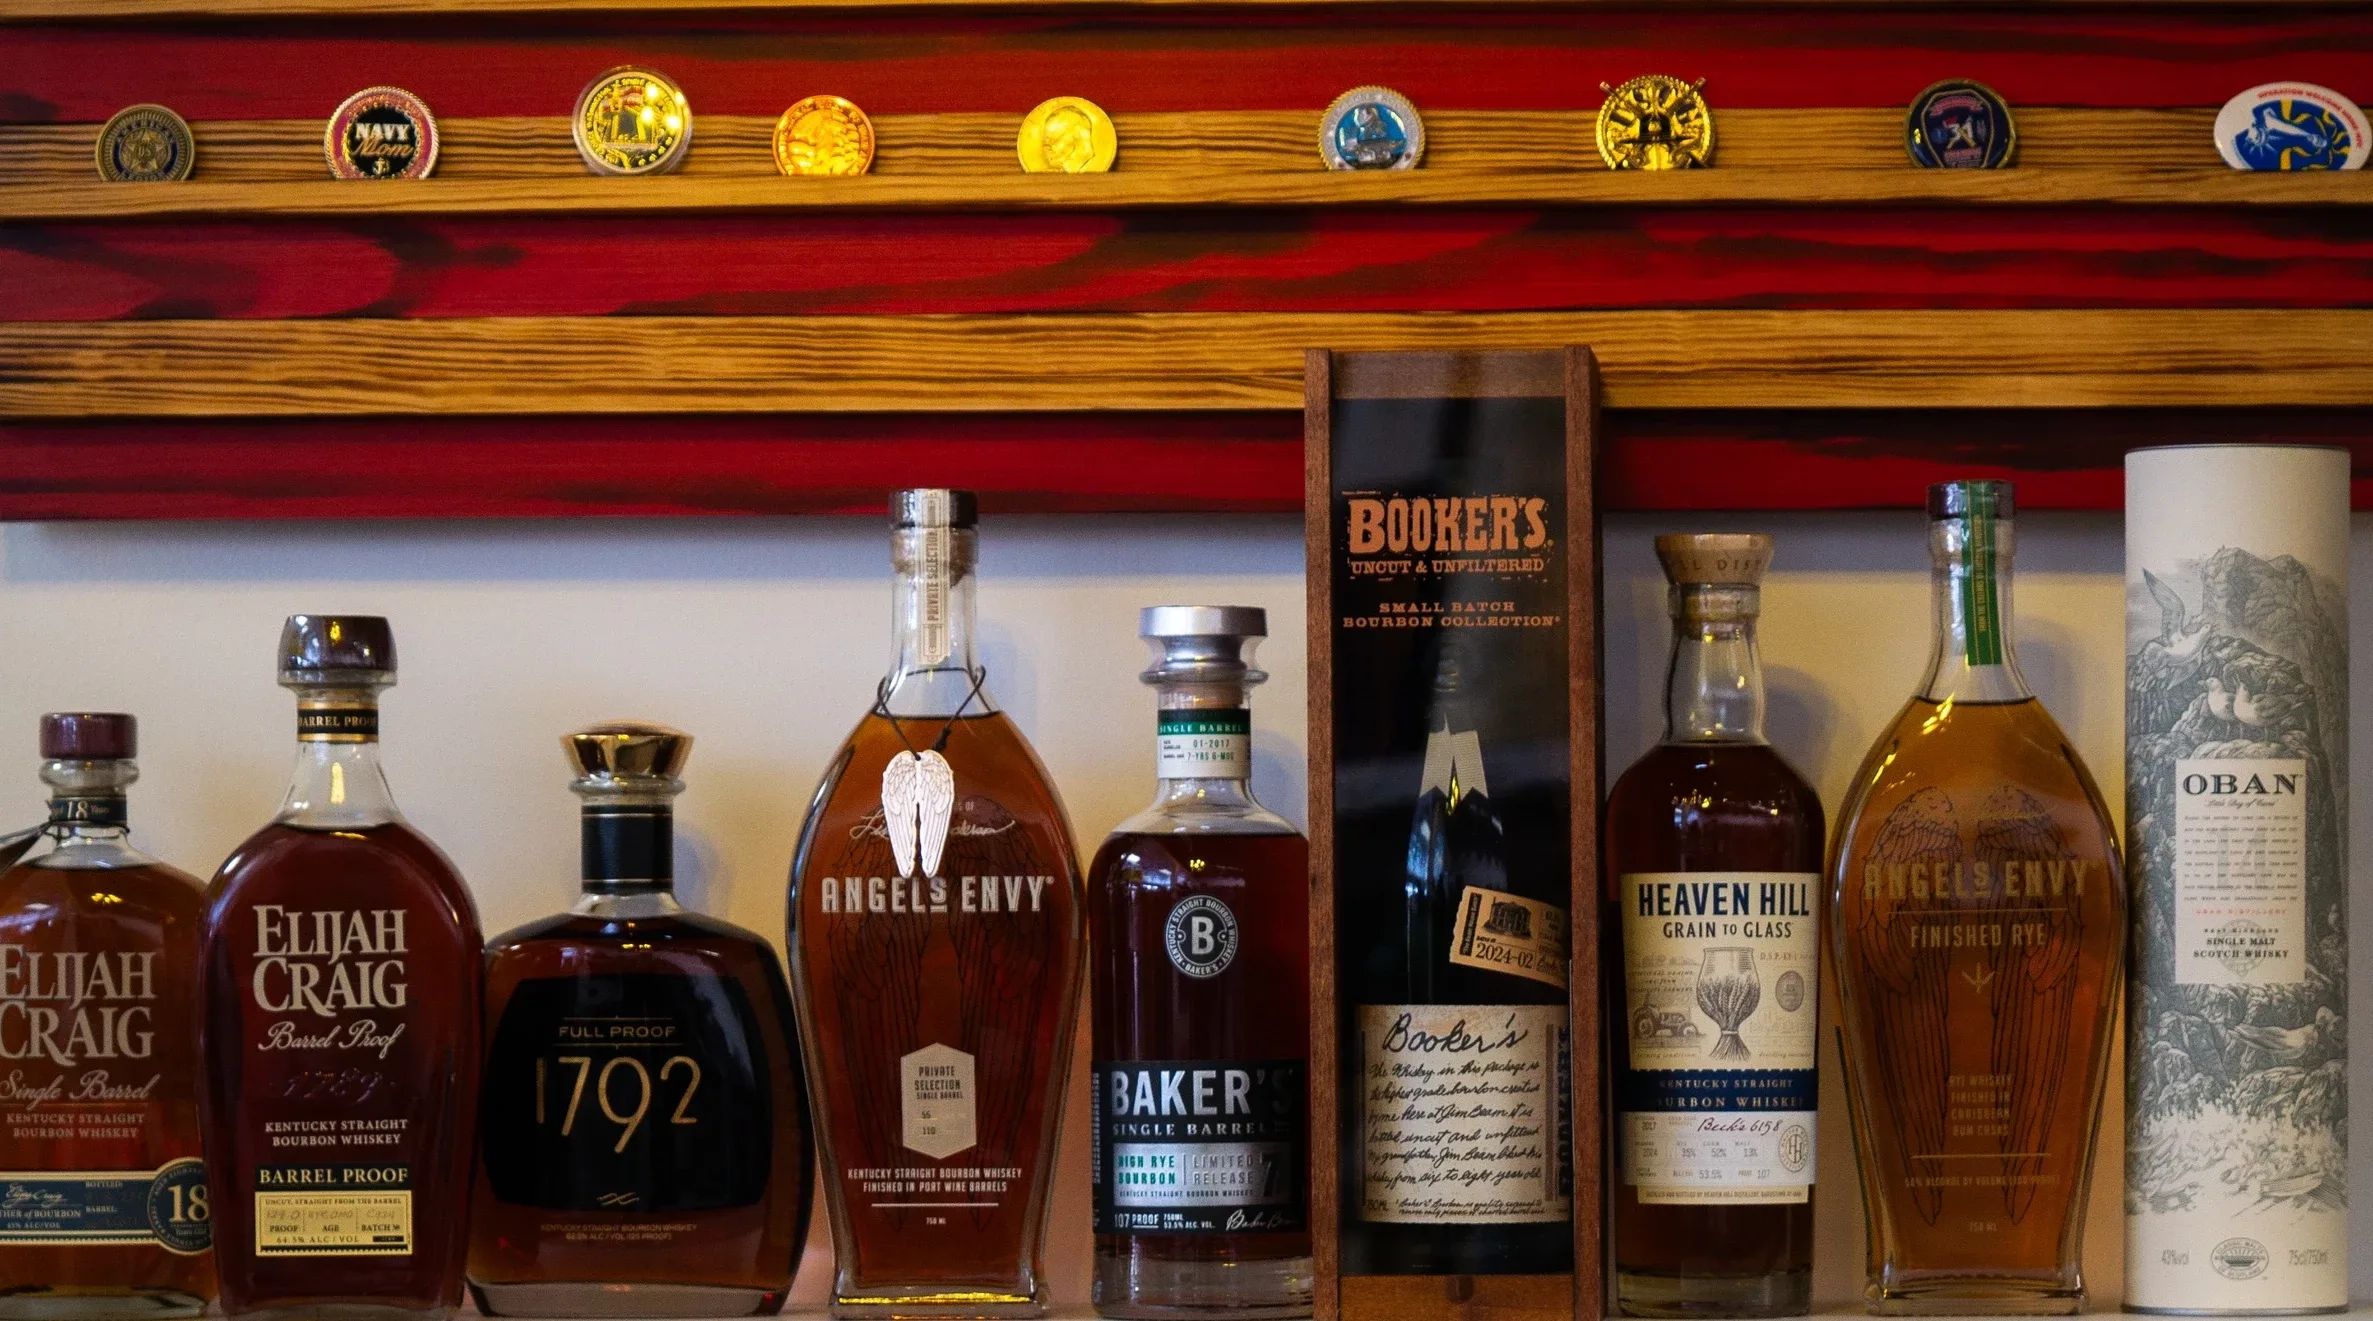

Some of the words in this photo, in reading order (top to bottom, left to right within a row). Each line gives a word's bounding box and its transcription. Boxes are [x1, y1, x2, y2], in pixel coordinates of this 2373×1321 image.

[355, 123, 411, 141] NAVY
[350, 135, 415, 156] Mom
[1349, 497, 1547, 554] BOOKER'S
[925, 531, 939, 581] SELECTION
[1352, 560, 1411, 574] UNCUT
[1415, 560, 1428, 573] &
[1432, 558, 1544, 573] UNFILTERED
[926, 581, 939, 622] PRIVATE
[1379, 603, 1444, 613] SMALL
[1452, 602, 1515, 612] BATCH
[1343, 617, 1434, 628] BOURBON
[1159, 724, 1193, 733] SINGLE
[1200, 723, 1243, 732] BARREL
[2182, 773, 2300, 796] OBAN
[68, 801, 88, 820] 18
[2004, 859, 2090, 897] ENVY
[1638, 883, 1750, 916] HEAVEN
[1759, 882, 1810, 916] HILL
[1172, 899, 1205, 926] STRAIGHT
[1205, 898, 1234, 926] BOURBON
[252, 904, 408, 964] ELIJAH
[1191, 916, 1215, 955] B
[1662, 922, 1716, 938] GRAIN
[1723, 923, 1737, 936] TO
[1743, 922, 1793, 938] GLASS
[1910, 924, 2002, 949] FINISHED
[2012, 923, 2046, 946] RYE
[1167, 926, 1183, 964] KENTUCKY
[1222, 926, 1237, 967] WHISKEY
[2206, 937, 2246, 946] SINGLE
[2249, 937, 2276, 946] MALT
[1475, 942, 1534, 970] 2024-02
[2193, 950, 2240, 959] SCOTCH
[2244, 950, 2290, 959] WHISKY
[0, 942, 158, 1008] ELIJAH
[1185, 962, 1219, 975] BAKER'S
[252, 956, 407, 1017] CRAIG
[0, 1001, 155, 1066] CRAIG
[258, 1021, 343, 1050] Barrel
[338, 1019, 405, 1060] Proof
[559, 1026, 604, 1037] FULL
[610, 1026, 676, 1037] PROOF
[1382, 1012, 1529, 1053] Booker's
[918, 1066, 955, 1076] PRIVATE
[1457, 1060, 1481, 1076] this
[0, 1069, 64, 1111] Single
[69, 1069, 160, 1100] Barrel
[914, 1079, 961, 1091] SELECTION
[1659, 1080, 1728, 1088] KENTUCKY
[1733, 1080, 1793, 1088] STRAIGHT
[916, 1092, 938, 1100] SINGLE
[940, 1091, 964, 1099] BARREL
[536, 1056, 701, 1153] 1792
[1401, 1104, 1426, 1120] here
[6, 1113, 74, 1124] KENTUCKY
[78, 1113, 145, 1124] STRAIGHT
[264, 1121, 336, 1132] KENTUCKY
[340, 1119, 408, 1130] STRAIGHT
[1697, 1117, 1746, 1133] Beck's
[1750, 1117, 1784, 1136] 6158
[13, 1127, 74, 1138] BOURBON
[78, 1127, 138, 1138] WHISKEY
[922, 1126, 936, 1135] 110
[1112, 1124, 1176, 1136] SINGLE
[1187, 1122, 1267, 1135] BARREL
[1447, 1129, 1481, 1143] and
[272, 1135, 336, 1146] BOURBON
[340, 1133, 401, 1145] WHISKEY
[1118, 1155, 1144, 1168] HIGH
[1151, 1155, 1176, 1168] RYE
[1193, 1154, 1254, 1168] LIMITED
[259, 1169, 337, 1184] BARREL
[343, 1168, 408, 1183] PROOF
[848, 1168, 891, 1179] KENTUCKY
[894, 1168, 936, 1179] STRAIGHT
[939, 1168, 980, 1178] BOURBON
[983, 1168, 1023, 1178] WHISKEY
[1118, 1171, 1176, 1184] BOURBON
[1194, 1171, 1254, 1185] RELEASE
[863, 1181, 903, 1193] FINISHED
[905, 1181, 915, 1192] IN
[918, 1181, 942, 1192] PORT
[944, 1181, 966, 1192] WINE
[969, 1181, 1008, 1192] BARRELS
[168, 1184, 208, 1222] 18
[34, 1208, 81, 1219] BOURBON
[926, 1217, 938, 1225] 750
[1114, 1213, 1130, 1228] 107
[1132, 1213, 1159, 1225] PROOF
[269, 1225, 298, 1233] PROOF
[362, 1224, 390, 1232] BATCH
